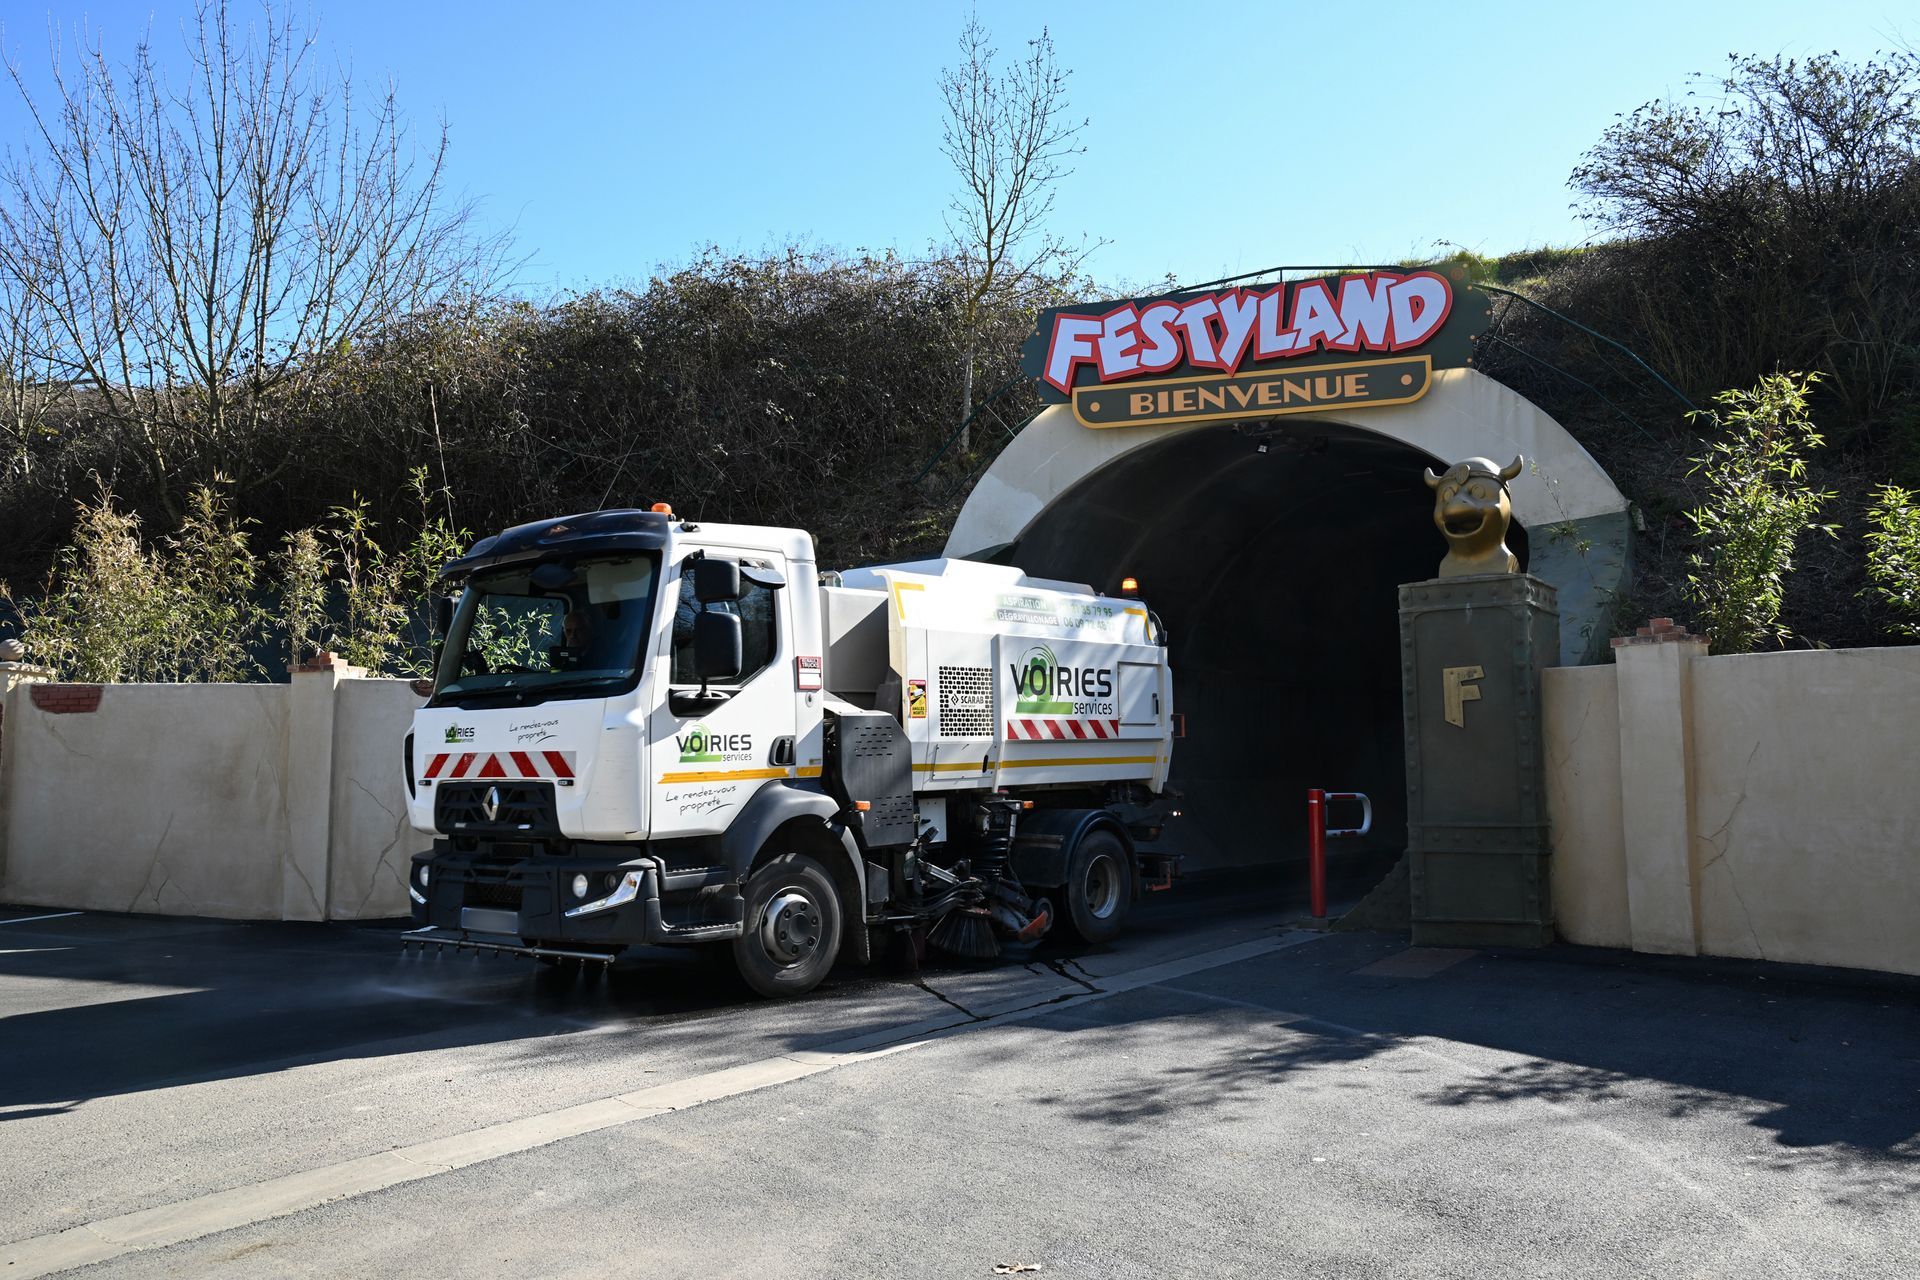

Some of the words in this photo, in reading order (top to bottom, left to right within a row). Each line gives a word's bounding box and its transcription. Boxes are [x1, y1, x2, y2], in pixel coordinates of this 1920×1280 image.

[1043, 271, 1454, 395] FESTYLAND
[1130, 374, 1369, 416] BIENVENUE
[1001, 596, 1047, 609] ASPIRATION
[1103, 607, 1113, 618] 95
[1063, 616, 1073, 627] 06
[1010, 664, 1112, 697] VOIRIES
[961, 695, 984, 704] SCARAB
[1442, 665, 1485, 729] F
[1074, 699, 1113, 715] services
[445, 727, 475, 738] VOIRIES
[509, 723, 518, 732] Le
[520, 719, 559, 730] rendez-vous
[675, 734, 752, 752] VOIRIES
[722, 752, 752, 762] services
[665, 791, 679, 802] Le
[682, 785, 737, 799] rendez-vous
[680, 796, 721, 816] propreté
